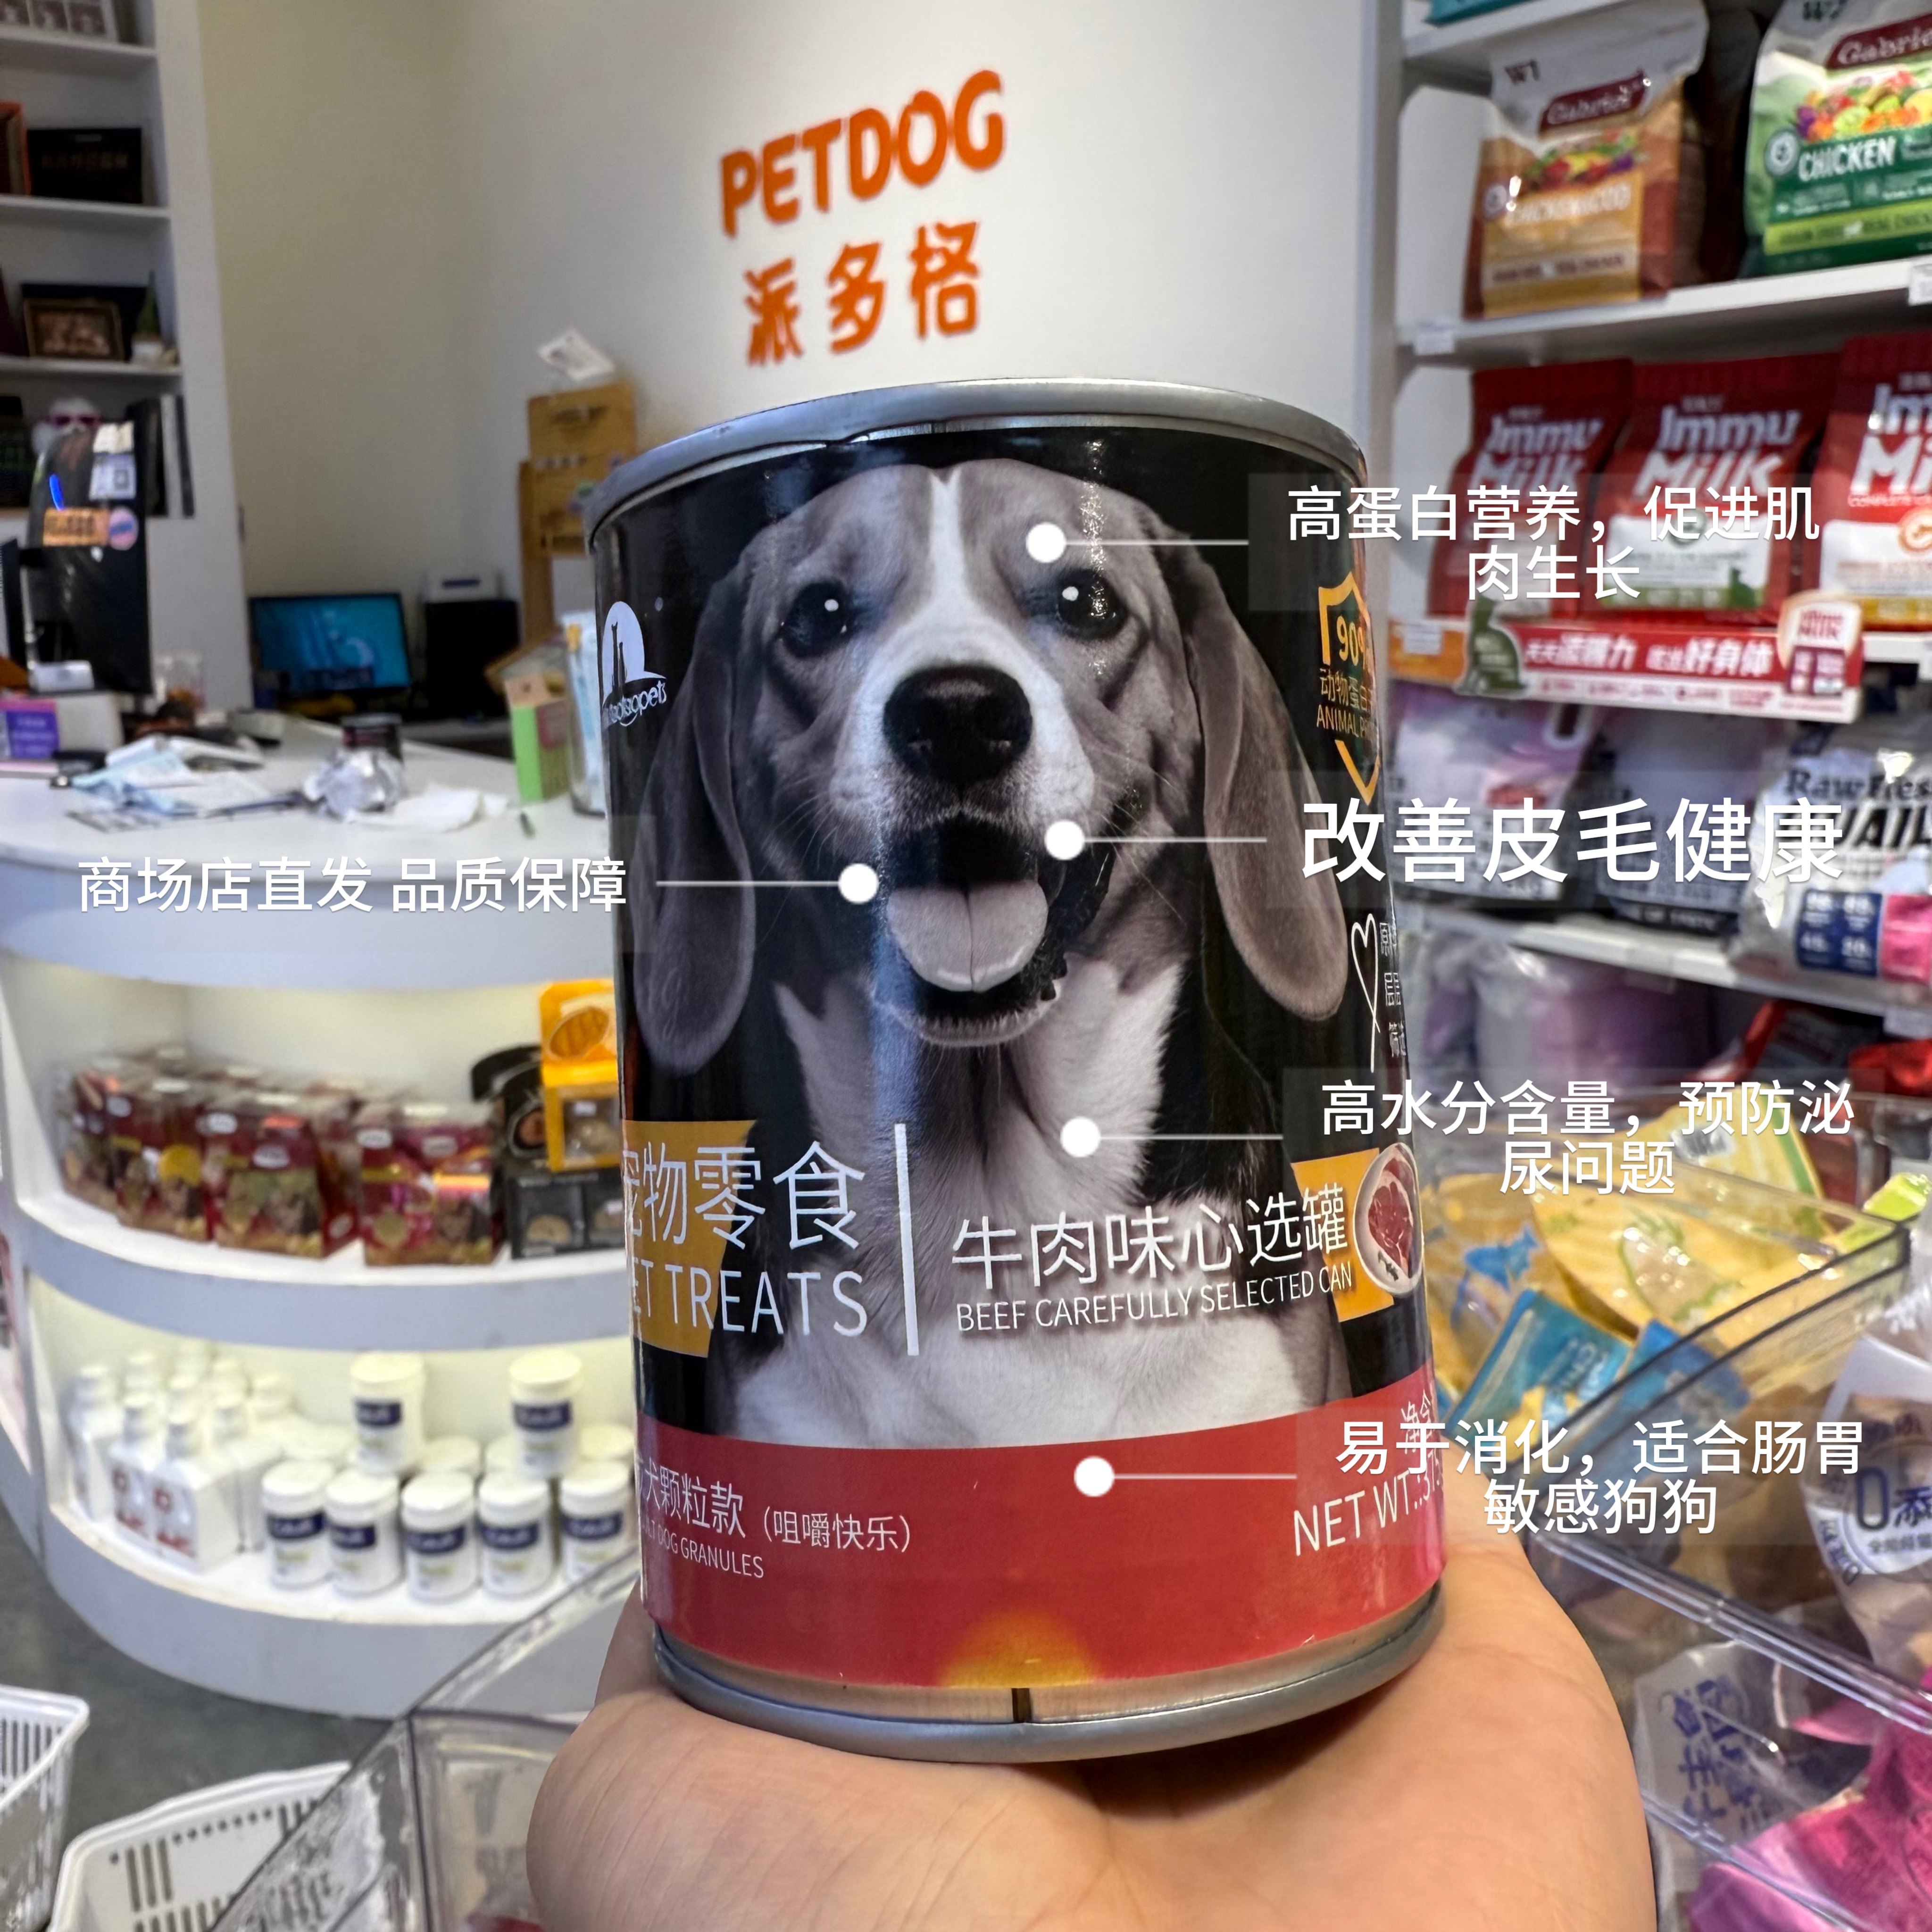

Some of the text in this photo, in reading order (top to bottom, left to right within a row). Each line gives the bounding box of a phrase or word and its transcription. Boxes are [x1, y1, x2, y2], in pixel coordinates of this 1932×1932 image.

[719, 69, 1006, 240] PETDOG
[1798, 136, 1897, 182] CHICKEN
[743, 222, 981, 367] 派多格
[1655, 405, 1803, 451] Immu
[1632, 450, 1784, 500] Milk
[1316, 704, 1359, 738] ANIMAL
[952, 1182, 1349, 1289] 牛肉味心选罐
[665, 1263, 867, 1337] TREATS
[957, 1261, 1352, 1332] BEEF CAREFULLY SELECTED CAN
[1293, 1491, 1366, 1557] NET
[681, 1537, 764, 1579] GRANULES
